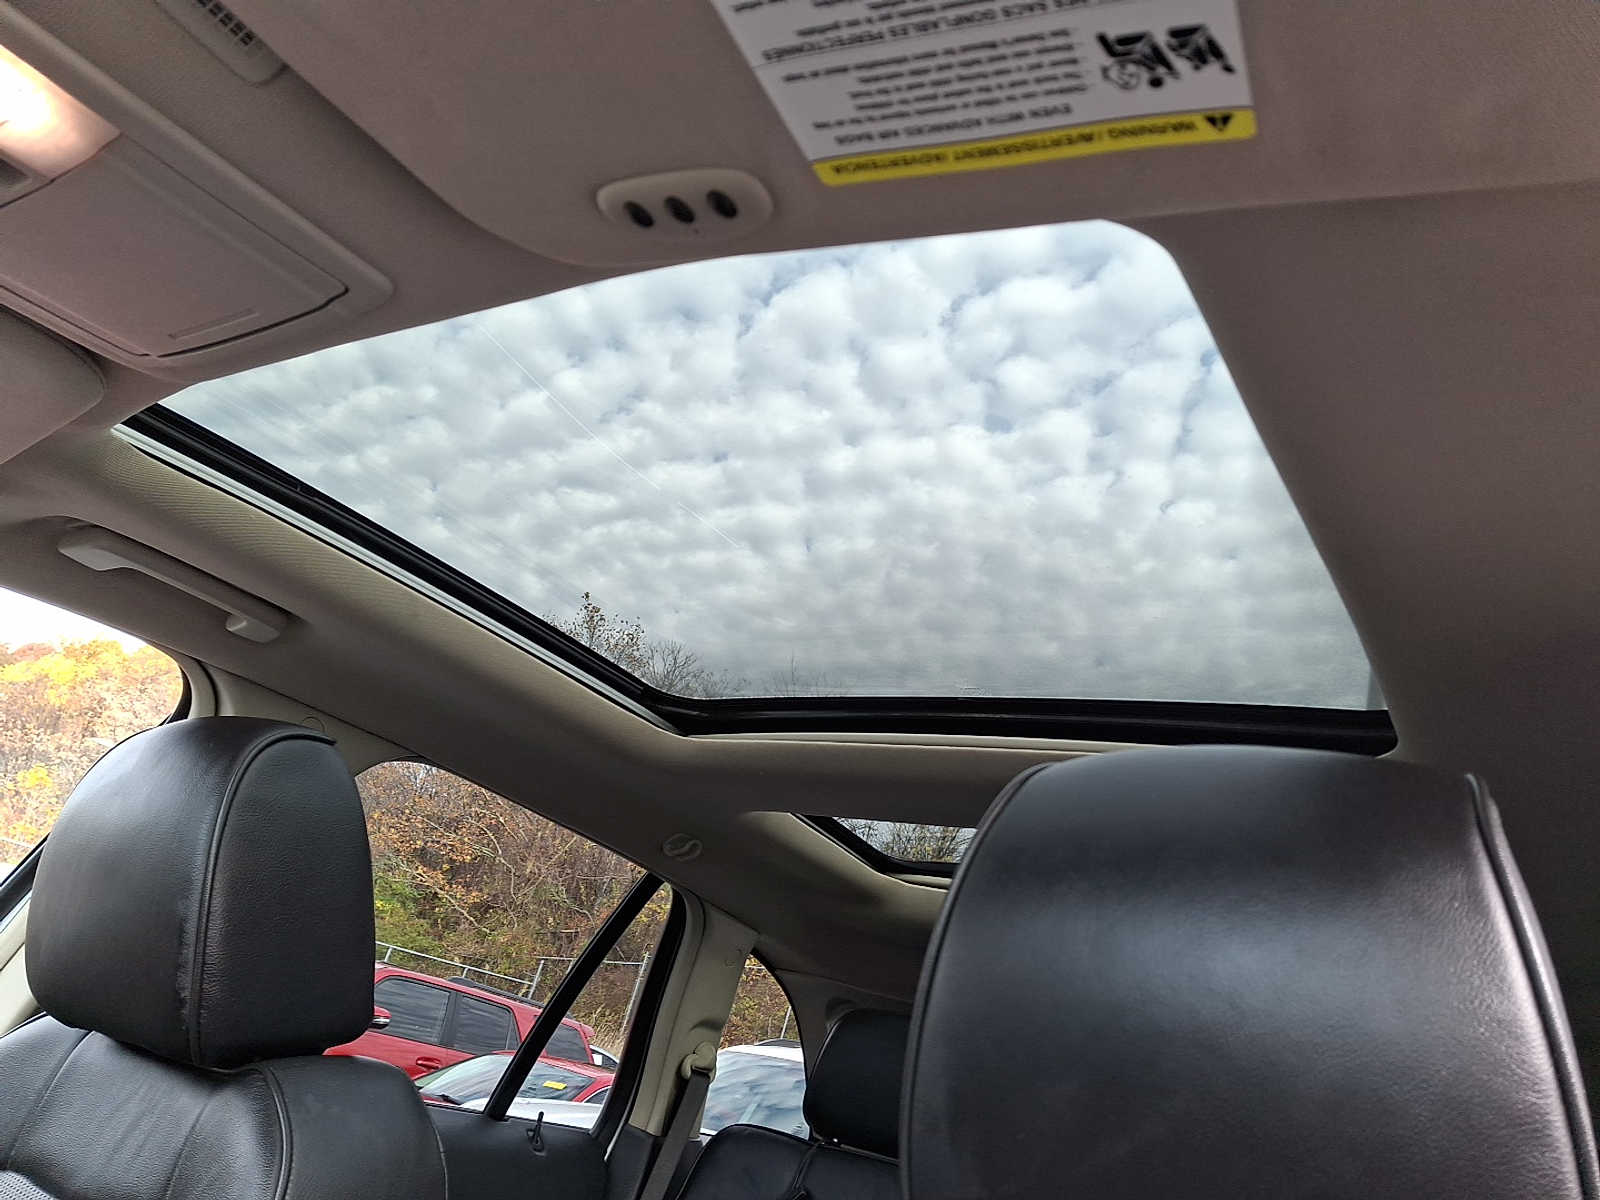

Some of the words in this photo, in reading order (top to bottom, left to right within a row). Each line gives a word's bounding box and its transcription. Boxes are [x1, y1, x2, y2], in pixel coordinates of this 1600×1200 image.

[1028, 102, 1073, 118] EVEN
[985, 112, 1026, 125] WITH
[877, 128, 901, 140] AIR
[904, 118, 982, 136] ADVANCED
[1108, 121, 1197, 138] WARNING
[834, 131, 874, 146] BAGS
